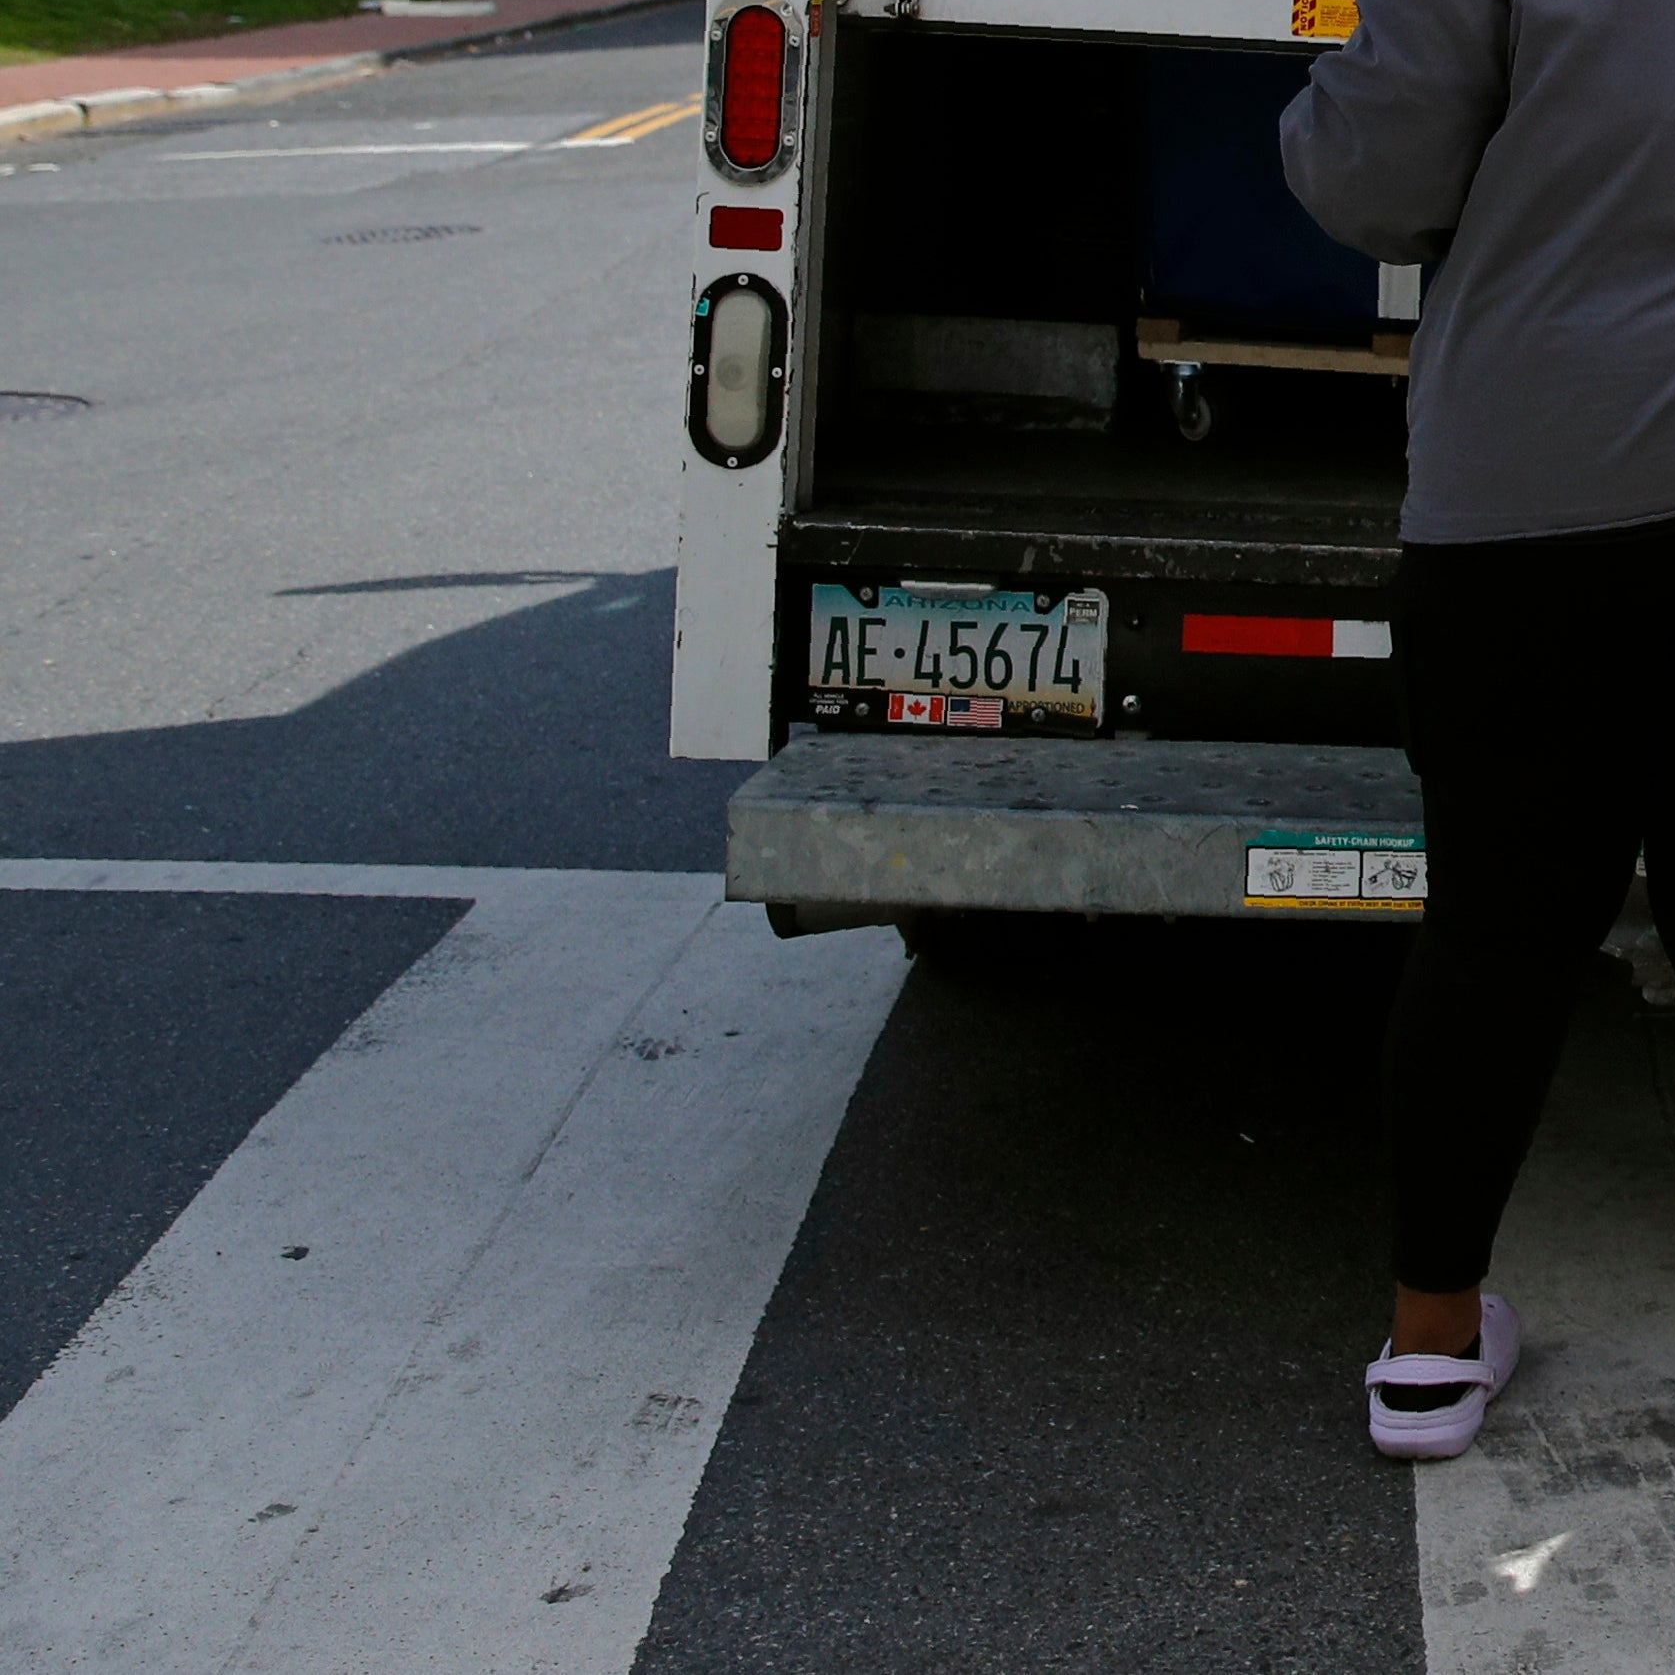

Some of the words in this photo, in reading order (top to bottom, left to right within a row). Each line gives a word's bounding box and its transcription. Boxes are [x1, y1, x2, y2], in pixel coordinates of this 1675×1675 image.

[884, 595, 1031, 613] ARIZONA
[1069, 607, 1098, 617] PERM
[816, 705, 841, 715] PAID
[1314, 836, 1378, 847] SAFETY-CHAIN
[1379, 838, 1415, 848] HOOKUP
